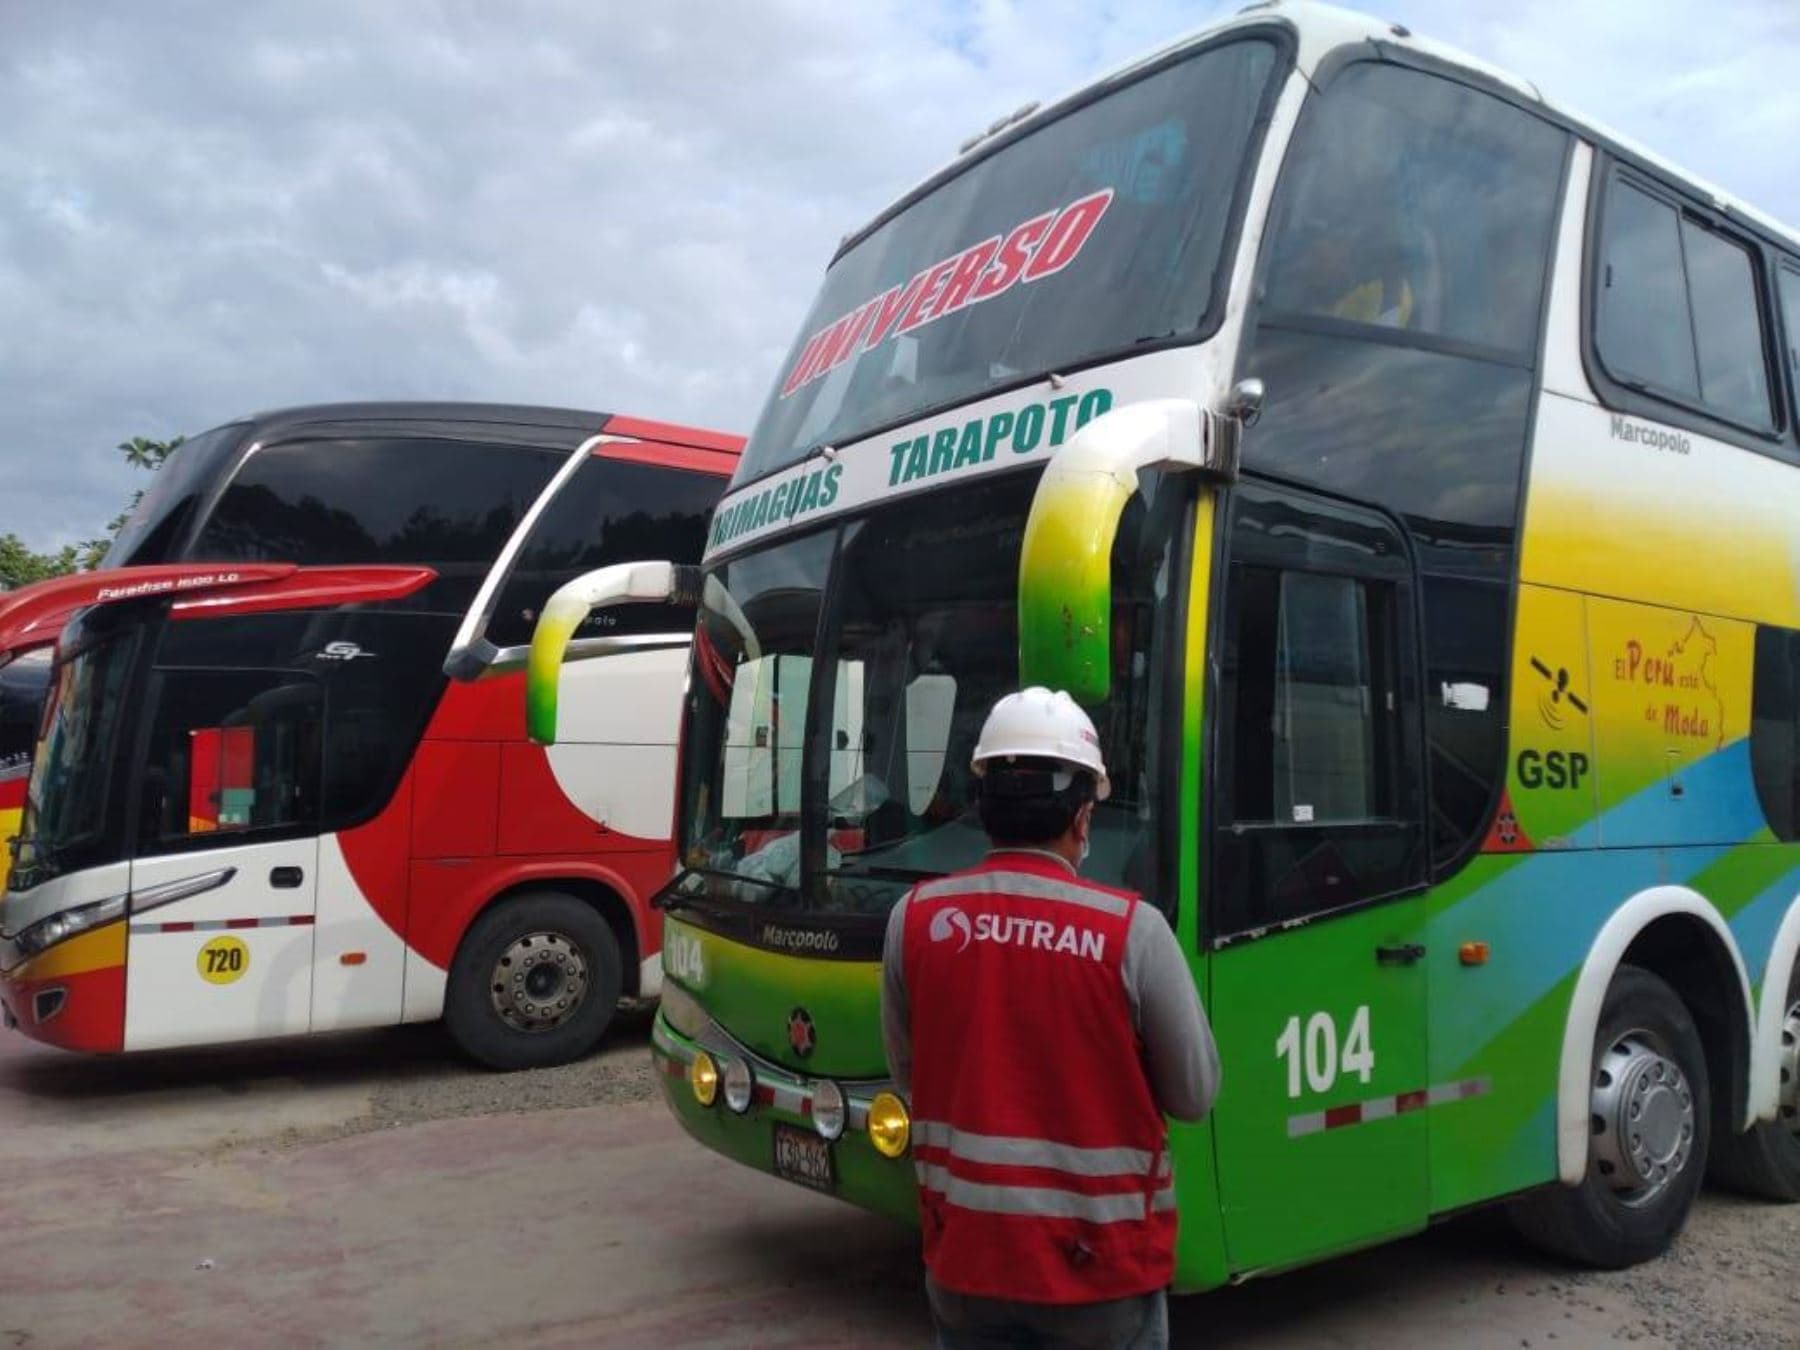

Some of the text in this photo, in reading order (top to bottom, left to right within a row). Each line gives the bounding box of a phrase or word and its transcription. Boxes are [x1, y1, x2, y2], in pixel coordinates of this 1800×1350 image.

[781, 188, 1115, 399] UNIVERSO
[888, 388, 1113, 487] TARAPOTO
[1610, 414, 1690, 455] Marcopolo
[1664, 703, 1709, 737] Moda
[1517, 749, 1588, 789] GSP
[206, 947, 242, 973] 720
[669, 932, 704, 983] 104
[763, 924, 839, 951] Marcopolo
[974, 913, 1105, 962] SUTRAN
[1276, 1005, 1374, 1098] 104
